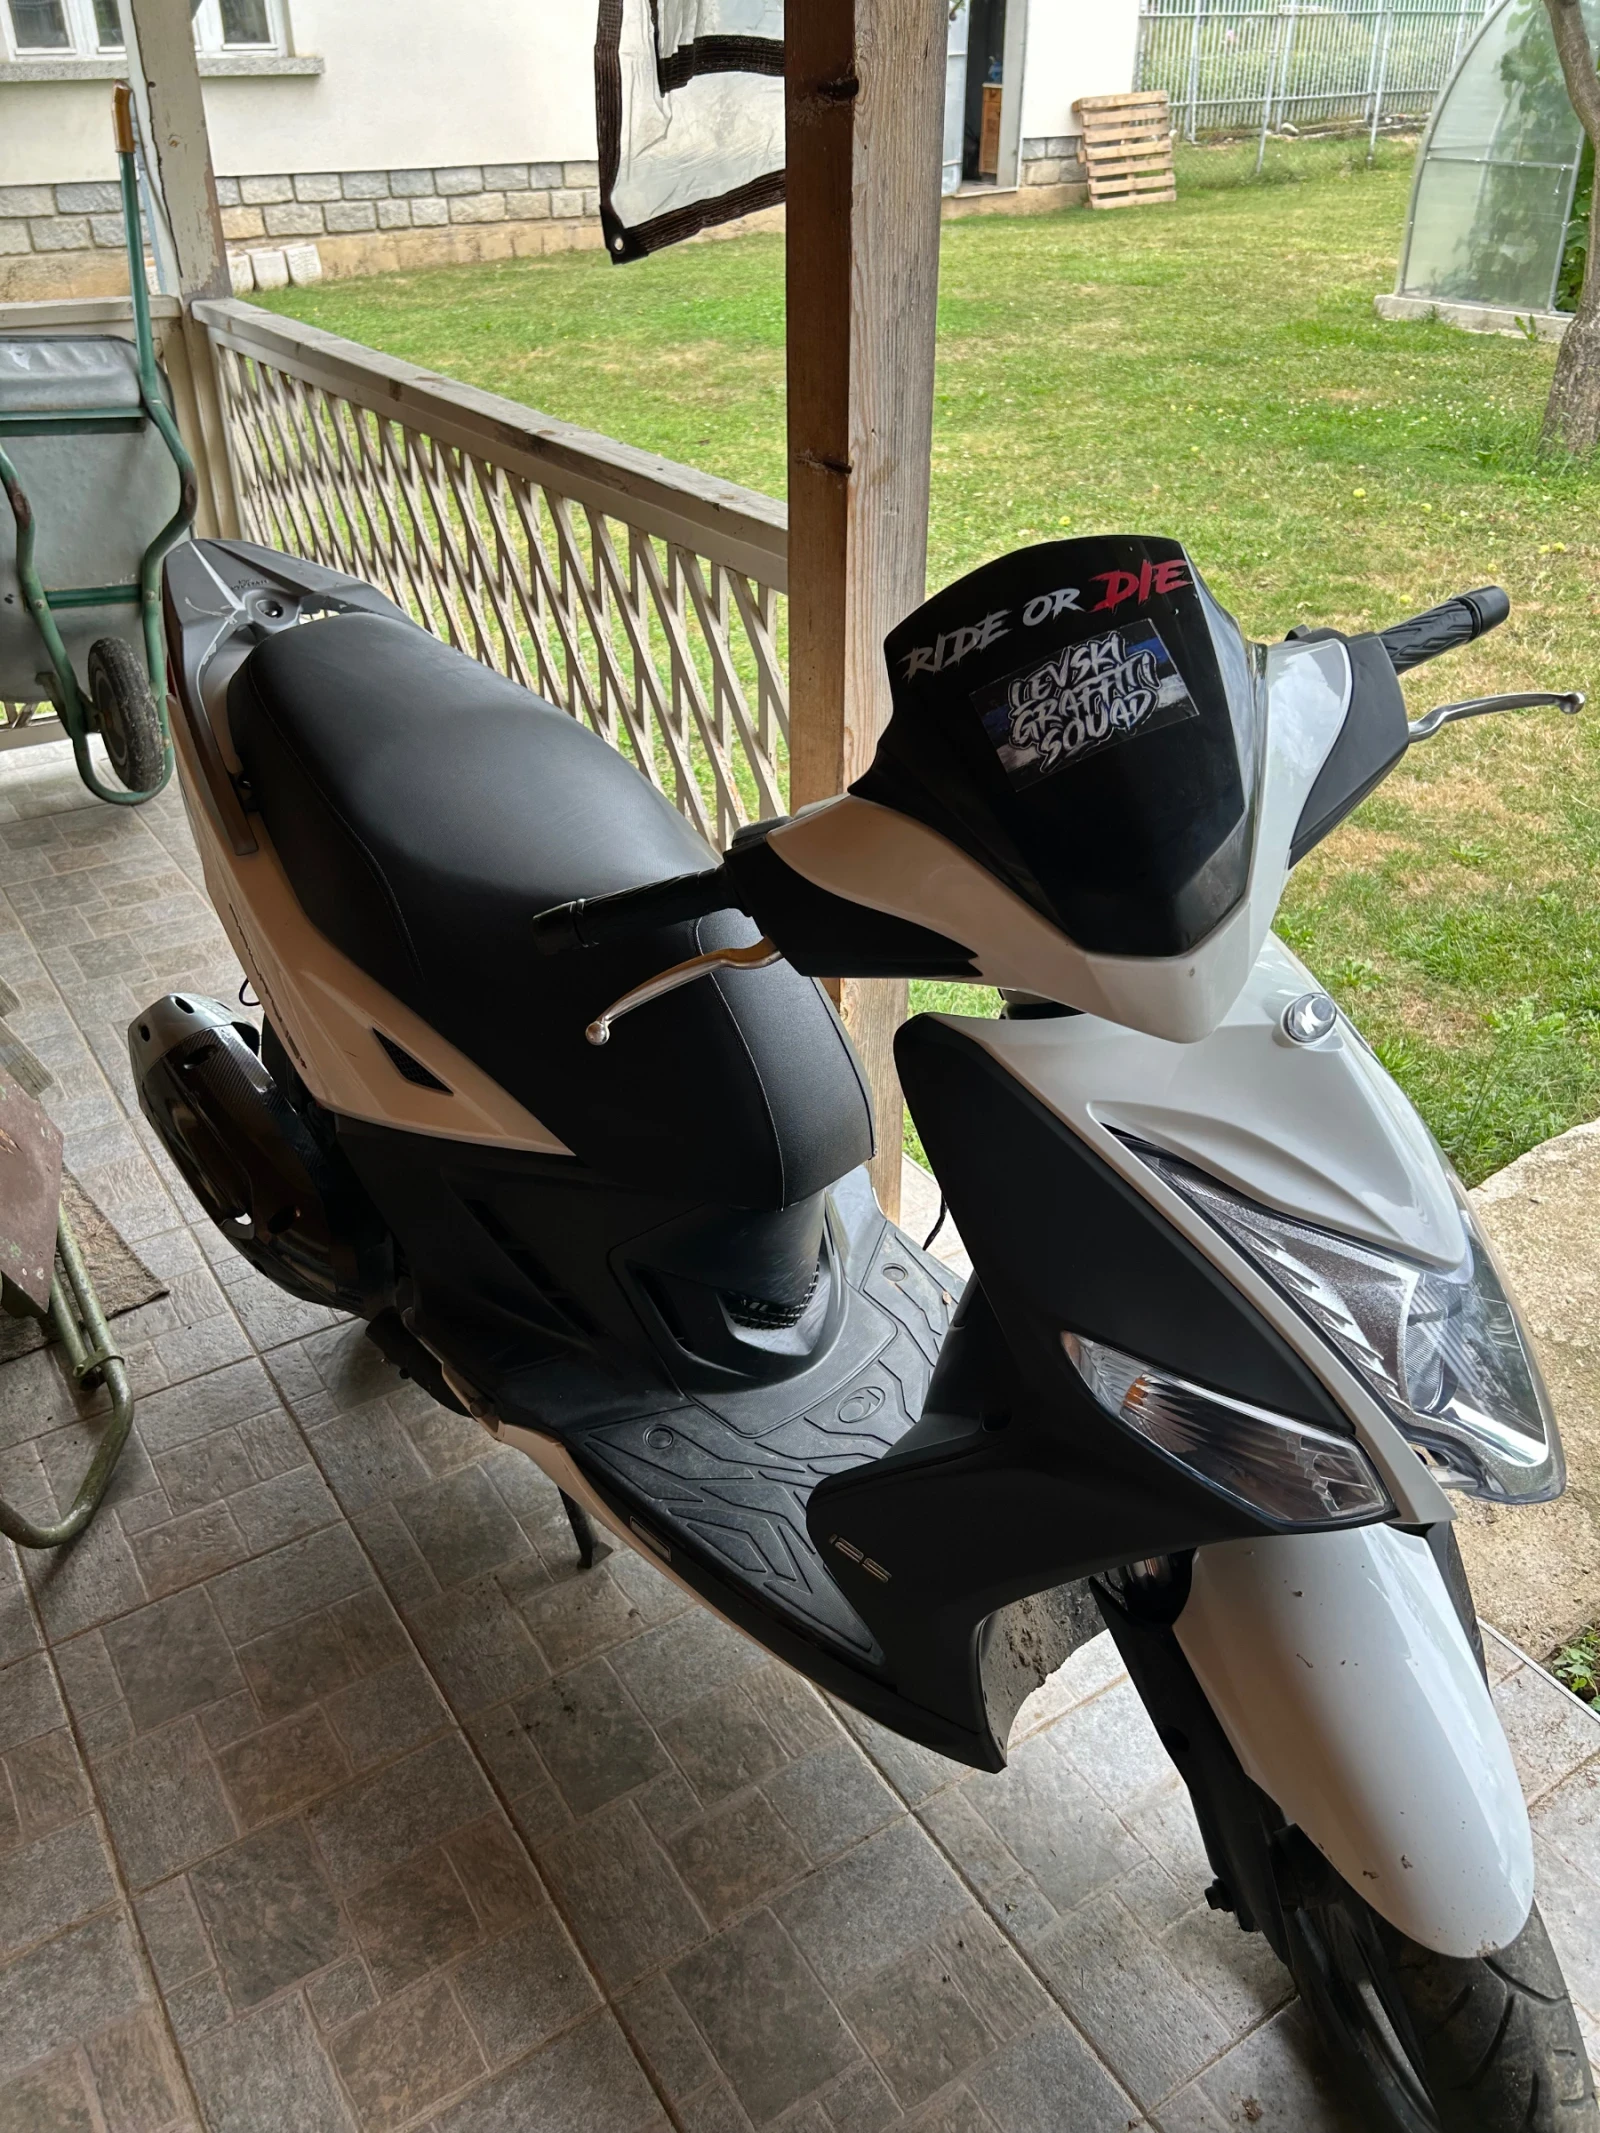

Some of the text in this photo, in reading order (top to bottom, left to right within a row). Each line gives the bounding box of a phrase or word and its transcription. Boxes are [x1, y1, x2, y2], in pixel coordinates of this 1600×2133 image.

[897, 559, 1194, 680] RIDE OR DIE
[1010, 633, 1125, 706] LEVSKI
[1011, 652, 1156, 746] GRAFFITI
[1040, 690, 1152, 770] SQUAD
[828, 1533, 892, 1583] 125
